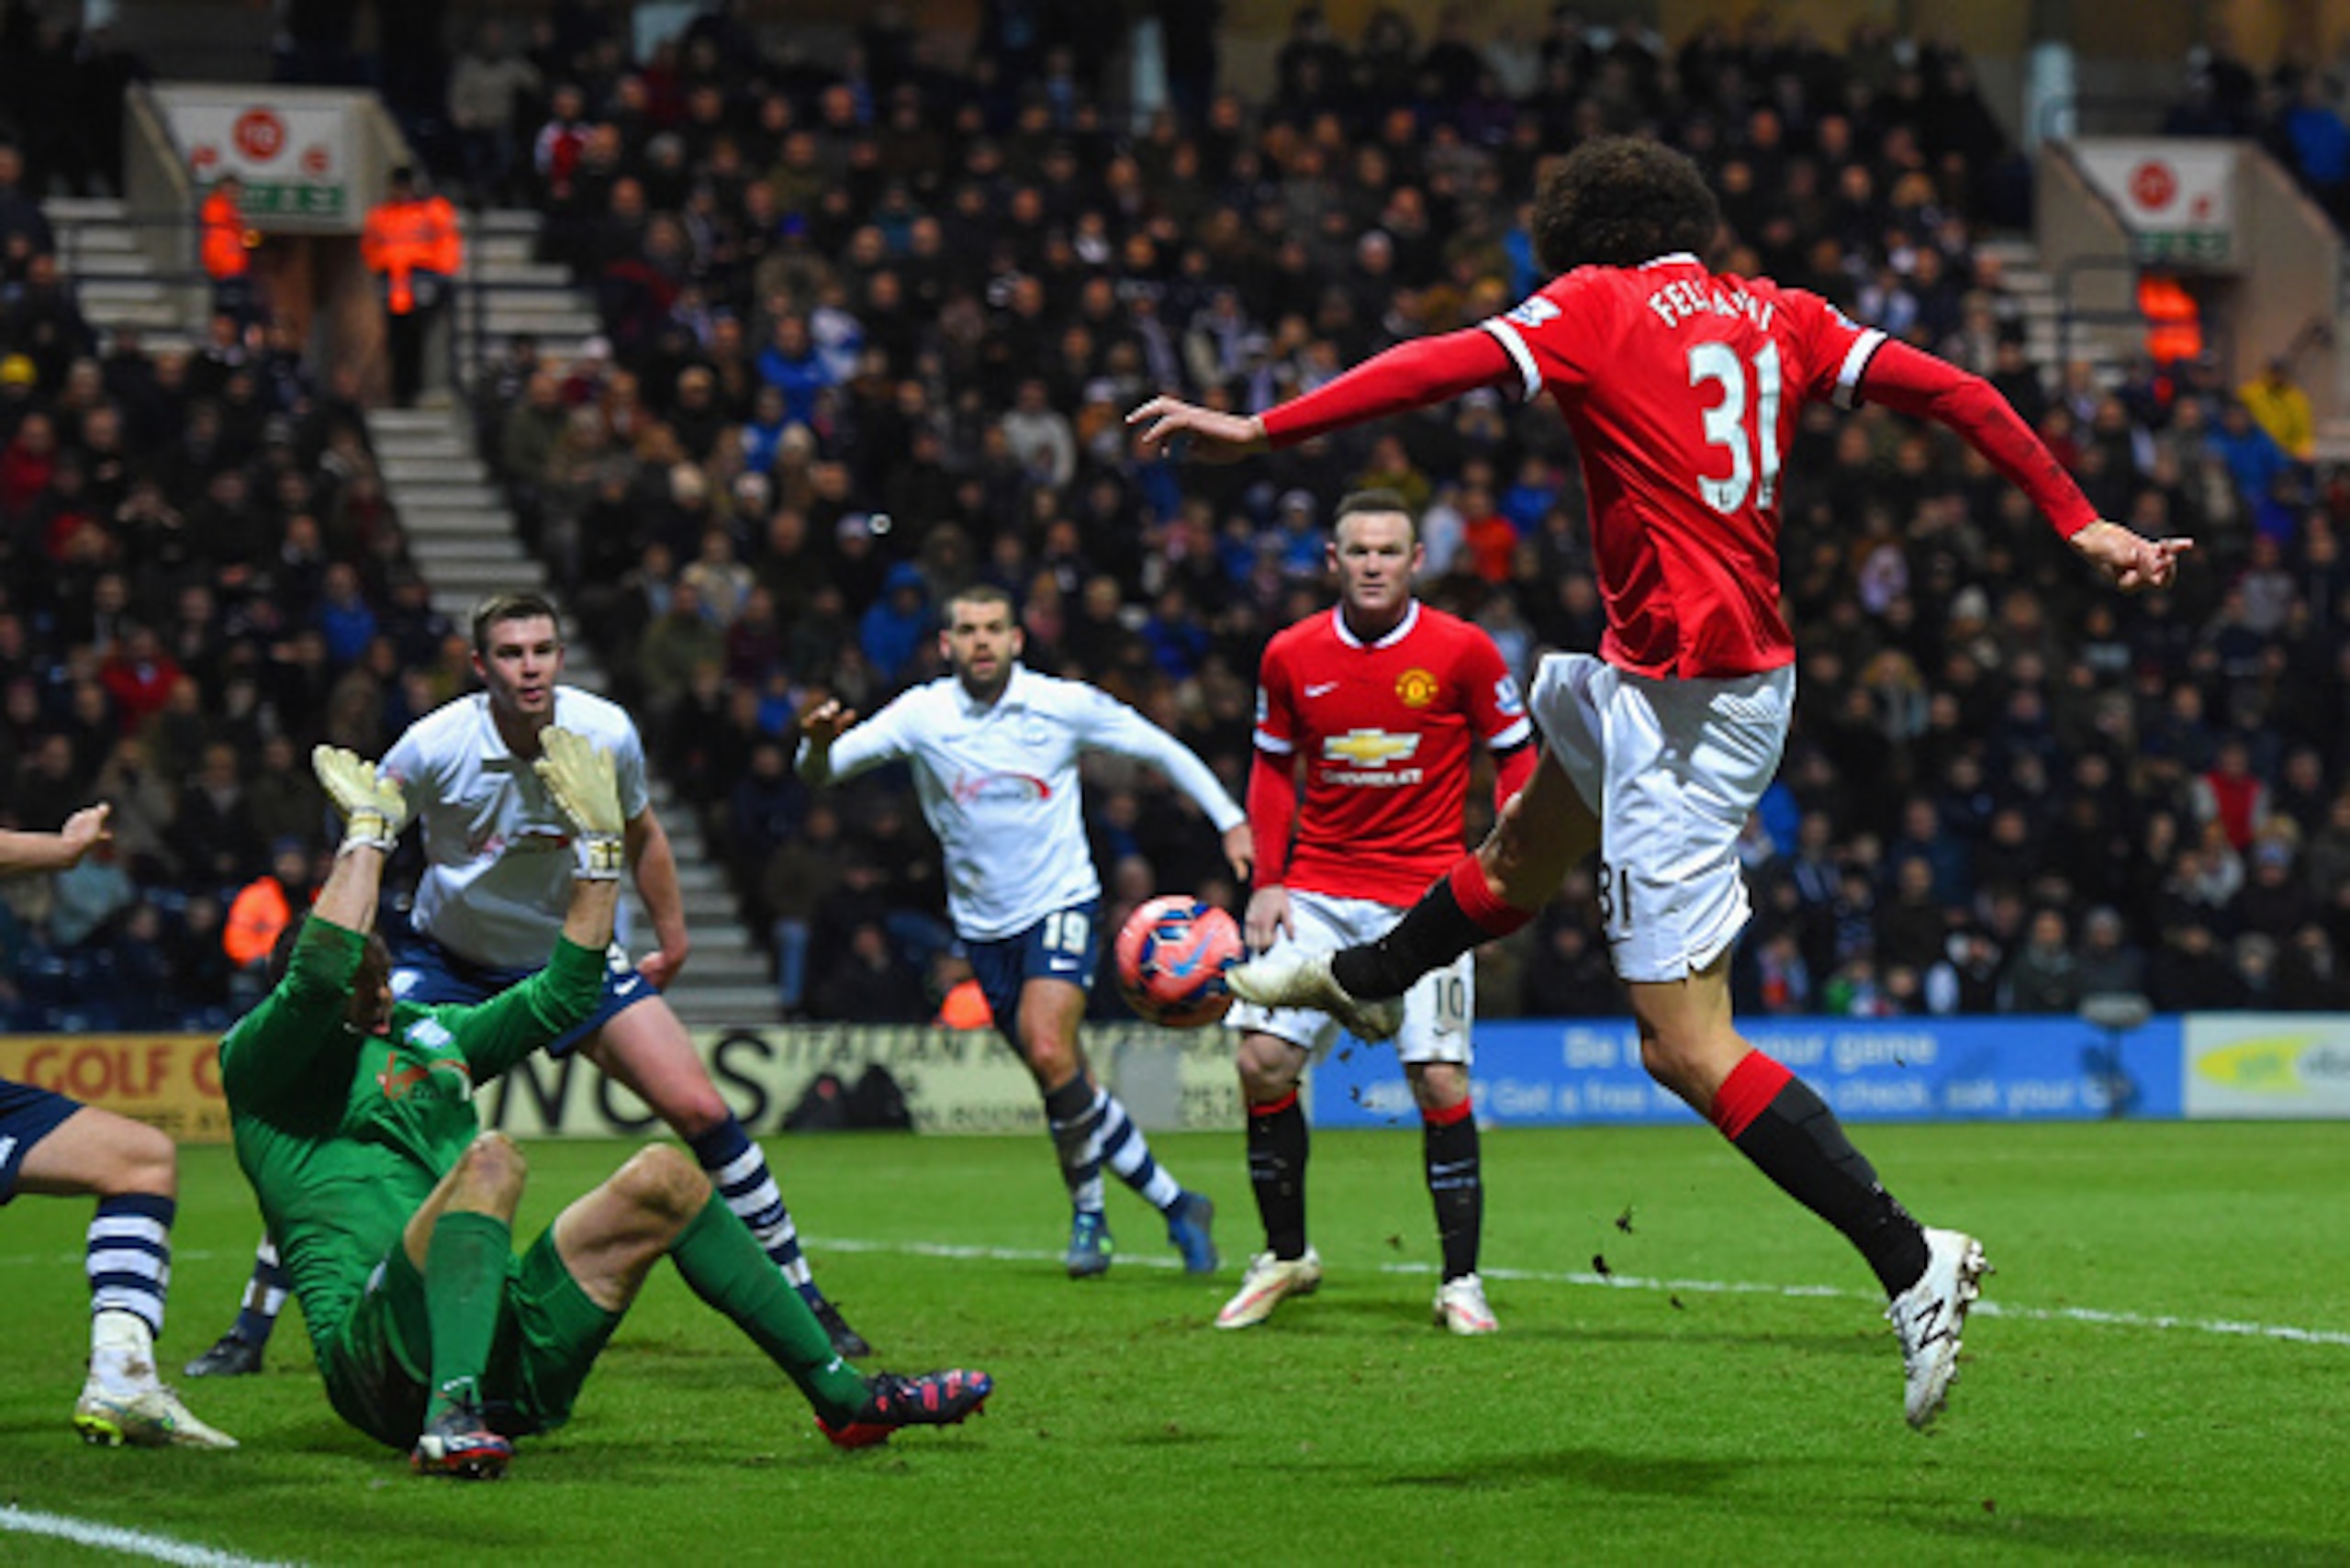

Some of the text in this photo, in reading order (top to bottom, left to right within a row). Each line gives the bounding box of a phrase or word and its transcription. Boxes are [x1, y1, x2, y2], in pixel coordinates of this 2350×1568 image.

[1687, 338, 1781, 514] 31
[1042, 911, 1090, 956] 19
[1435, 976, 1465, 1020] 10
[24, 1043, 223, 1100] GOLF C
[1834, 1032, 1938, 1074] game
